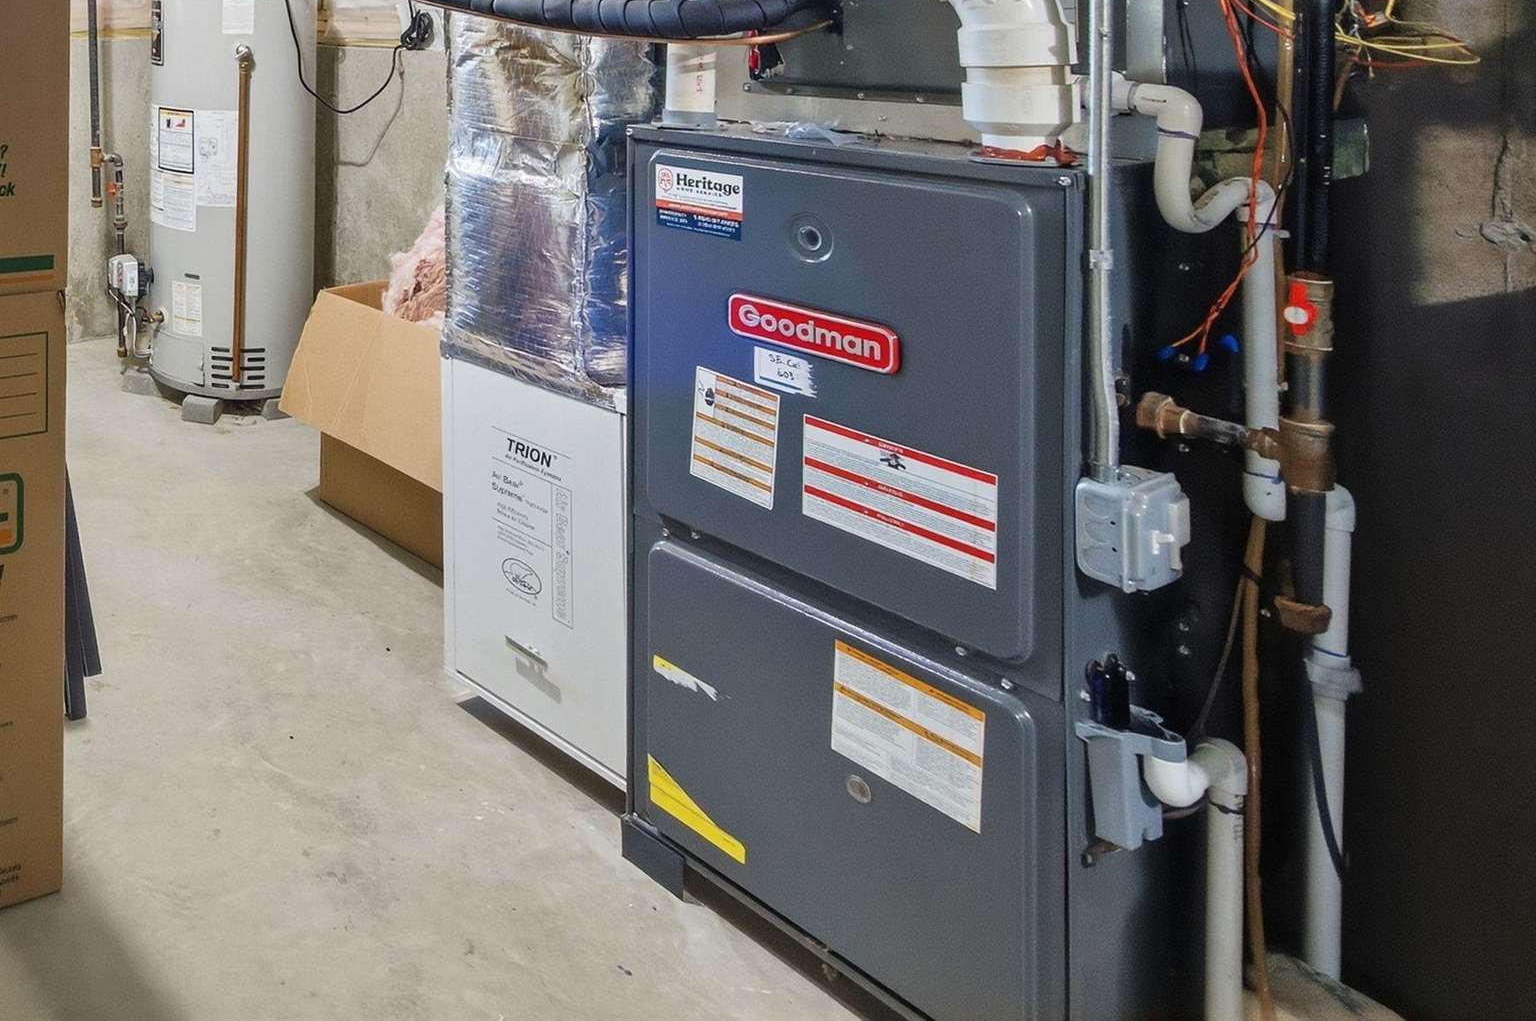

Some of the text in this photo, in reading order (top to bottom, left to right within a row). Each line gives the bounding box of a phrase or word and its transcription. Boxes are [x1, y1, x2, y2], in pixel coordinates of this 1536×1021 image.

[676, 173, 740, 196] Heritage
[738, 304, 881, 361] Goodman
[507, 438, 551, 467] TRION
